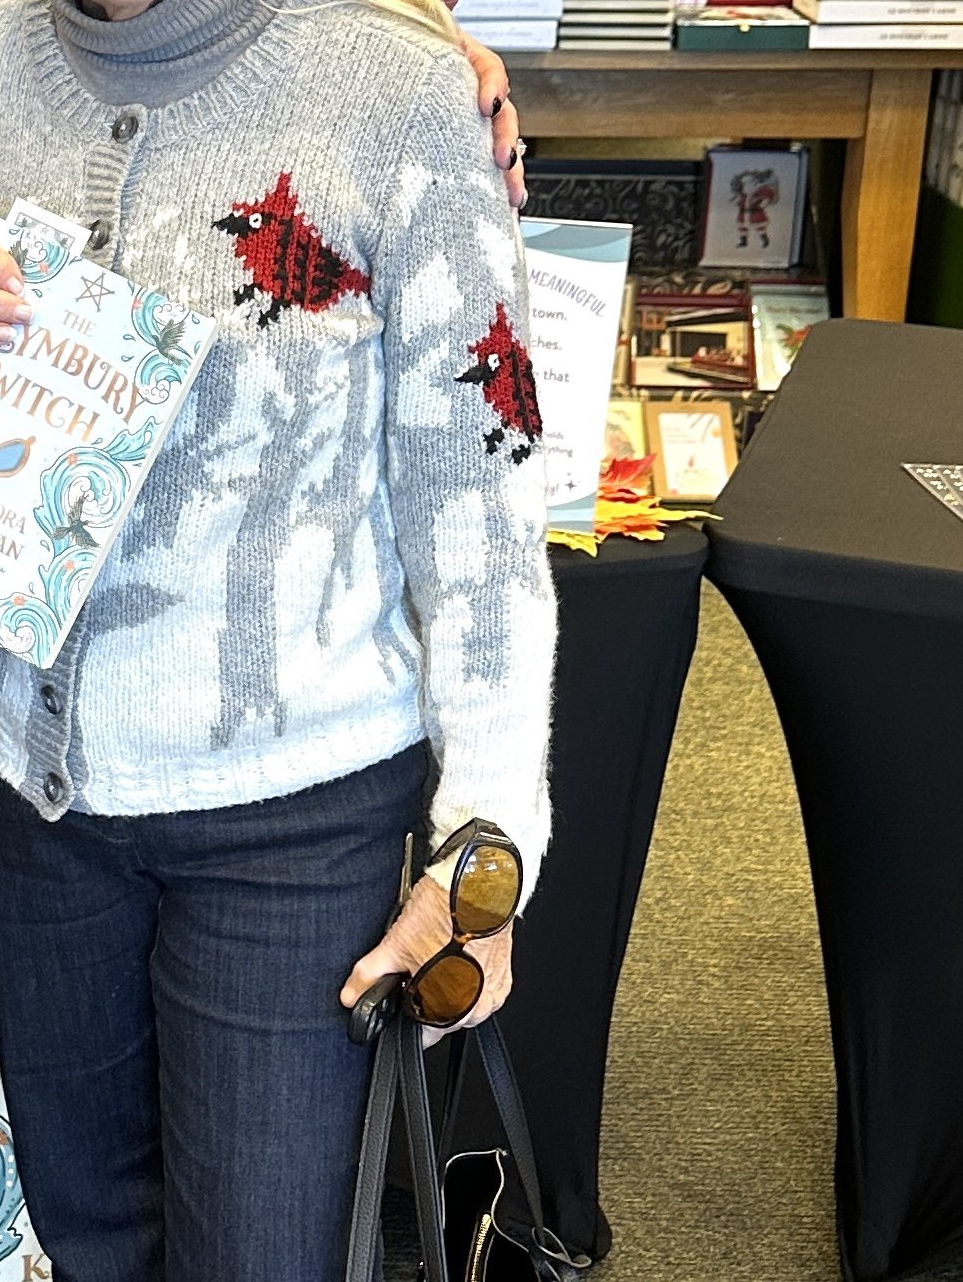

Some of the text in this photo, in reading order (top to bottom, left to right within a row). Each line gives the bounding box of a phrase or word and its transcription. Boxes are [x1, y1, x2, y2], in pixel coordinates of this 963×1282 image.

[529, 268, 607, 318] MEANINGFUL
[62, 309, 97, 338] THE
[532, 307, 568, 321] town.
[543, 368, 570, 383] that
